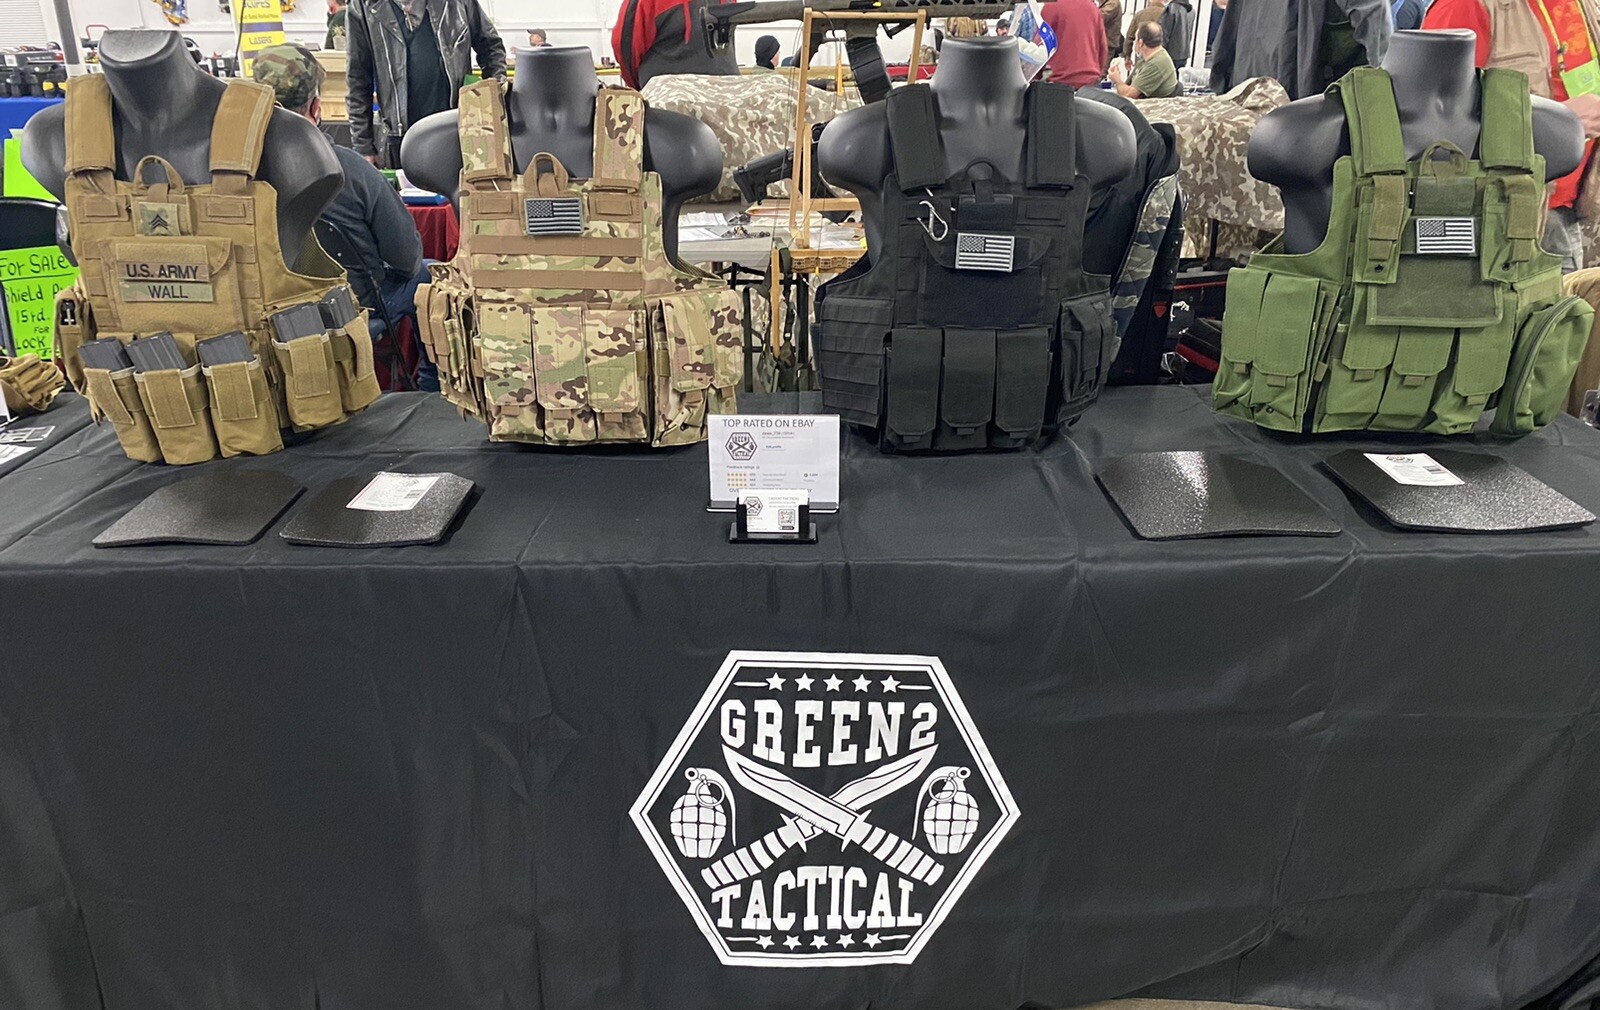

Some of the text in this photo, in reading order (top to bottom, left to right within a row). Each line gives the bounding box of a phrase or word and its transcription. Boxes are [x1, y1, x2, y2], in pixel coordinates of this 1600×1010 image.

[126, 263, 199, 279] U.S. ARMY
[148, 285, 189, 299] WALL
[722, 419, 815, 428] TOP RATED ON EBAY
[720, 699, 938, 768] GREEN2
[711, 865, 923, 931] TACTICAL
